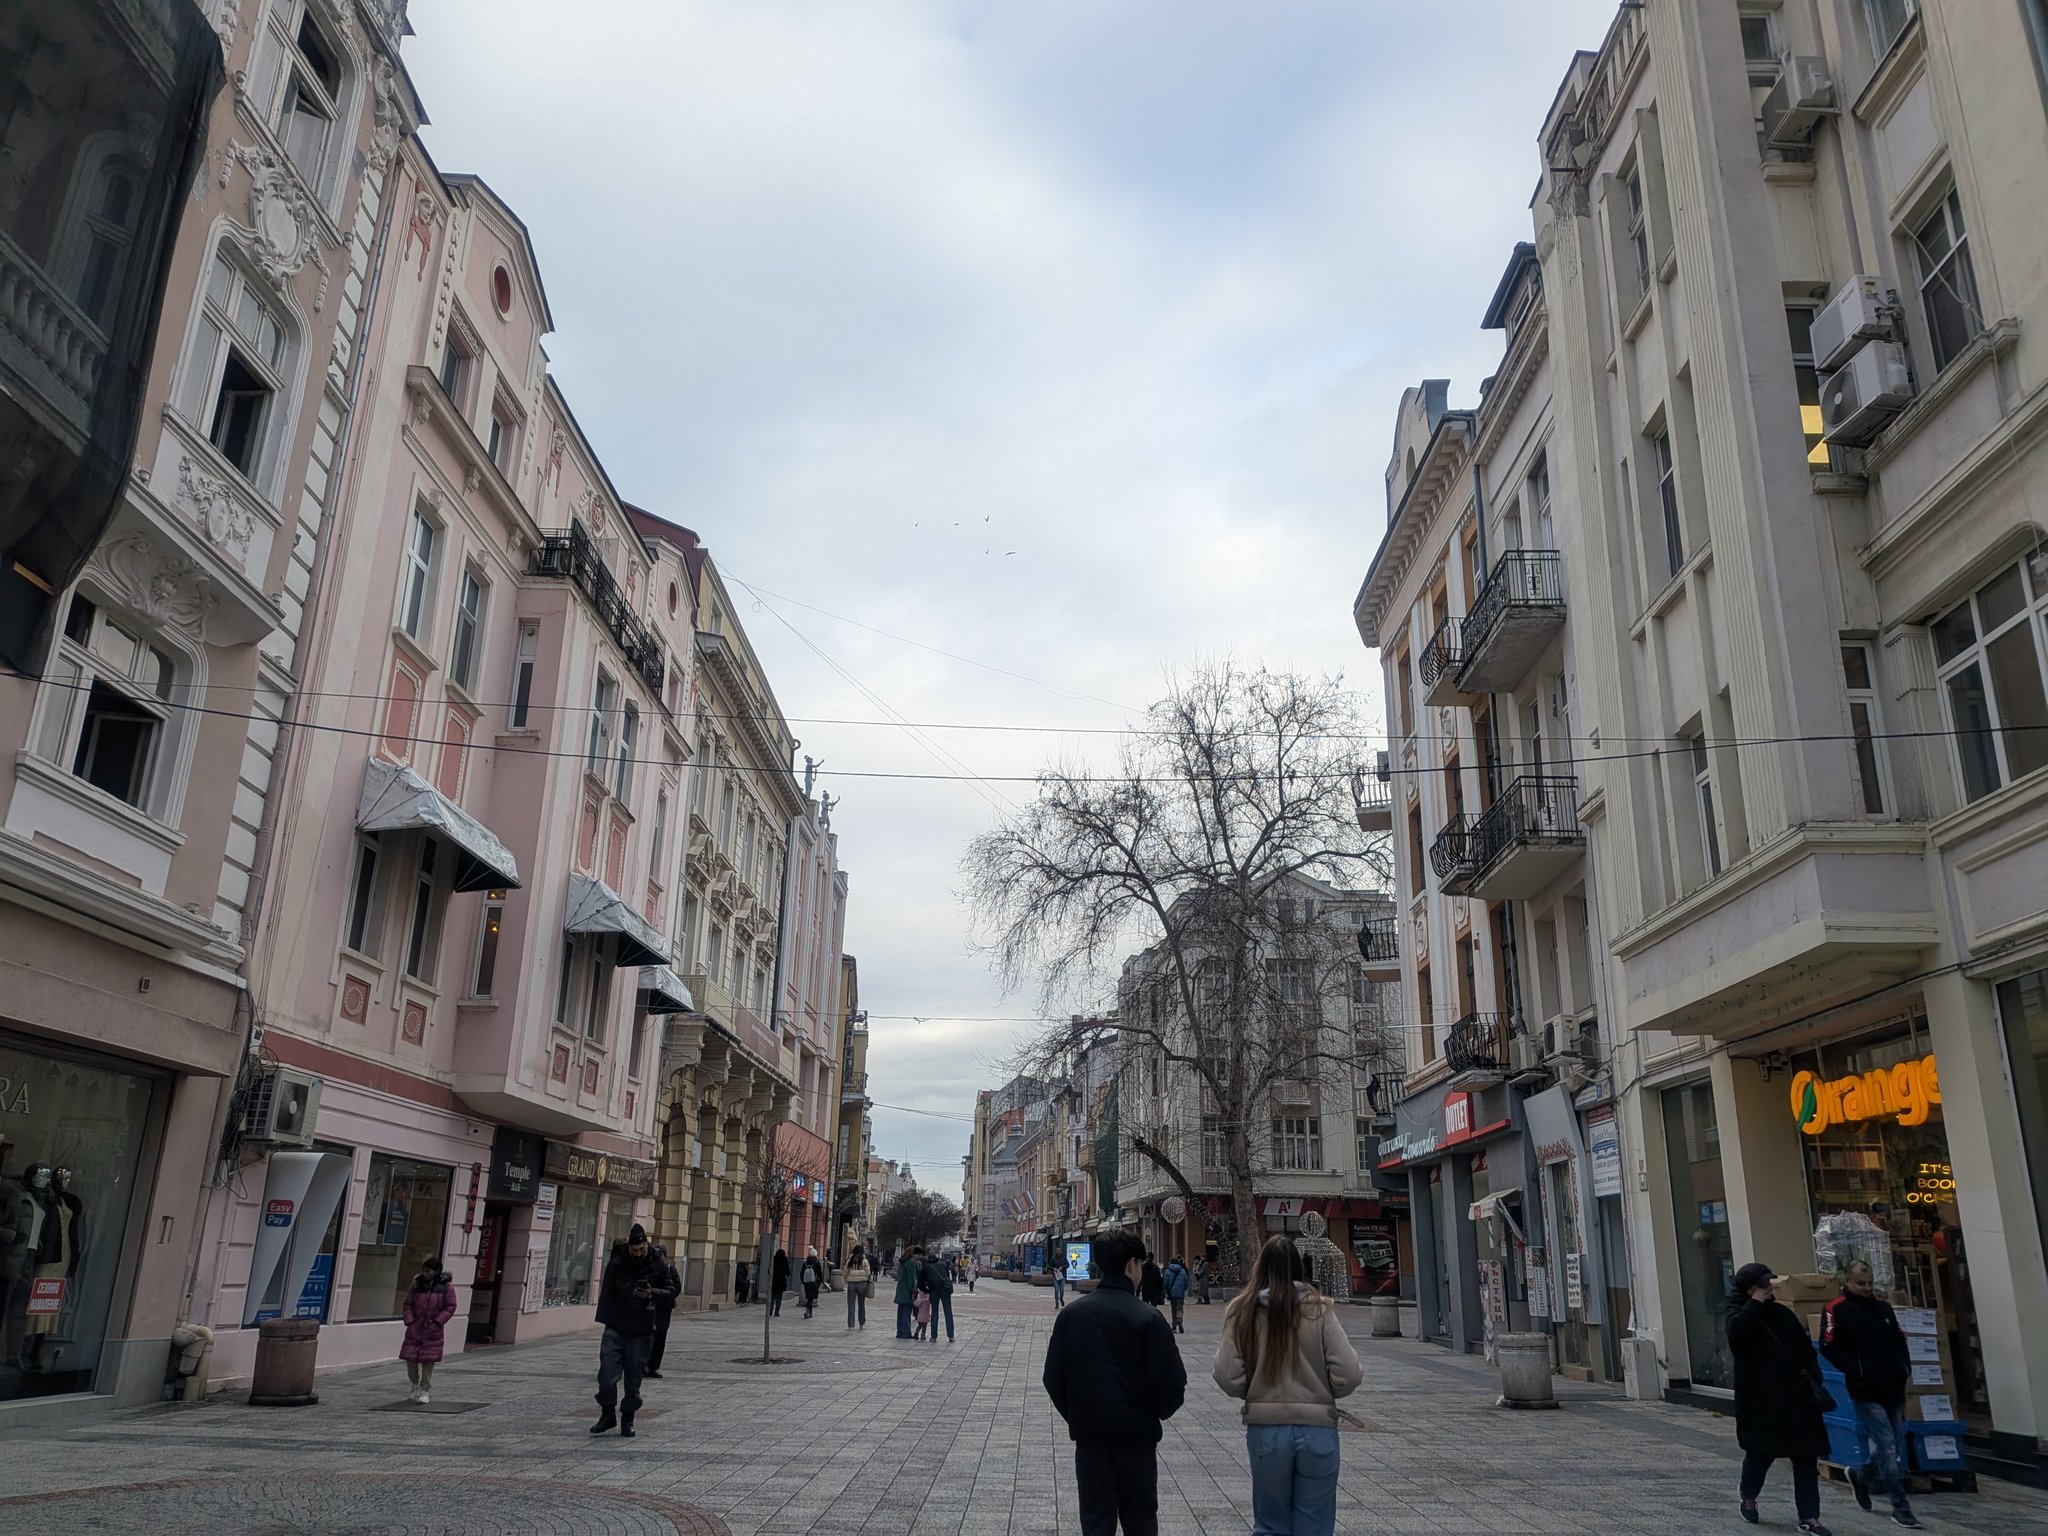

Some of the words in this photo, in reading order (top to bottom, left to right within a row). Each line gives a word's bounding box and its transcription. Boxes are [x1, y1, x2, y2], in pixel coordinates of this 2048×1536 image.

[1789, 1054, 1942, 1135] Orange
[1445, 1099, 1468, 1135] OUTLET
[505, 1161, 530, 1182] Temple
[568, 1155, 595, 1178] GRAND
[270, 1203, 292, 1214] Easy
[466, 1164, 481, 1232] CHANGE
[1276, 1202, 1290, 1216] A1
[267, 1214, 285, 1226] Pay
[477, 1217, 493, 1279] HOSTEL
